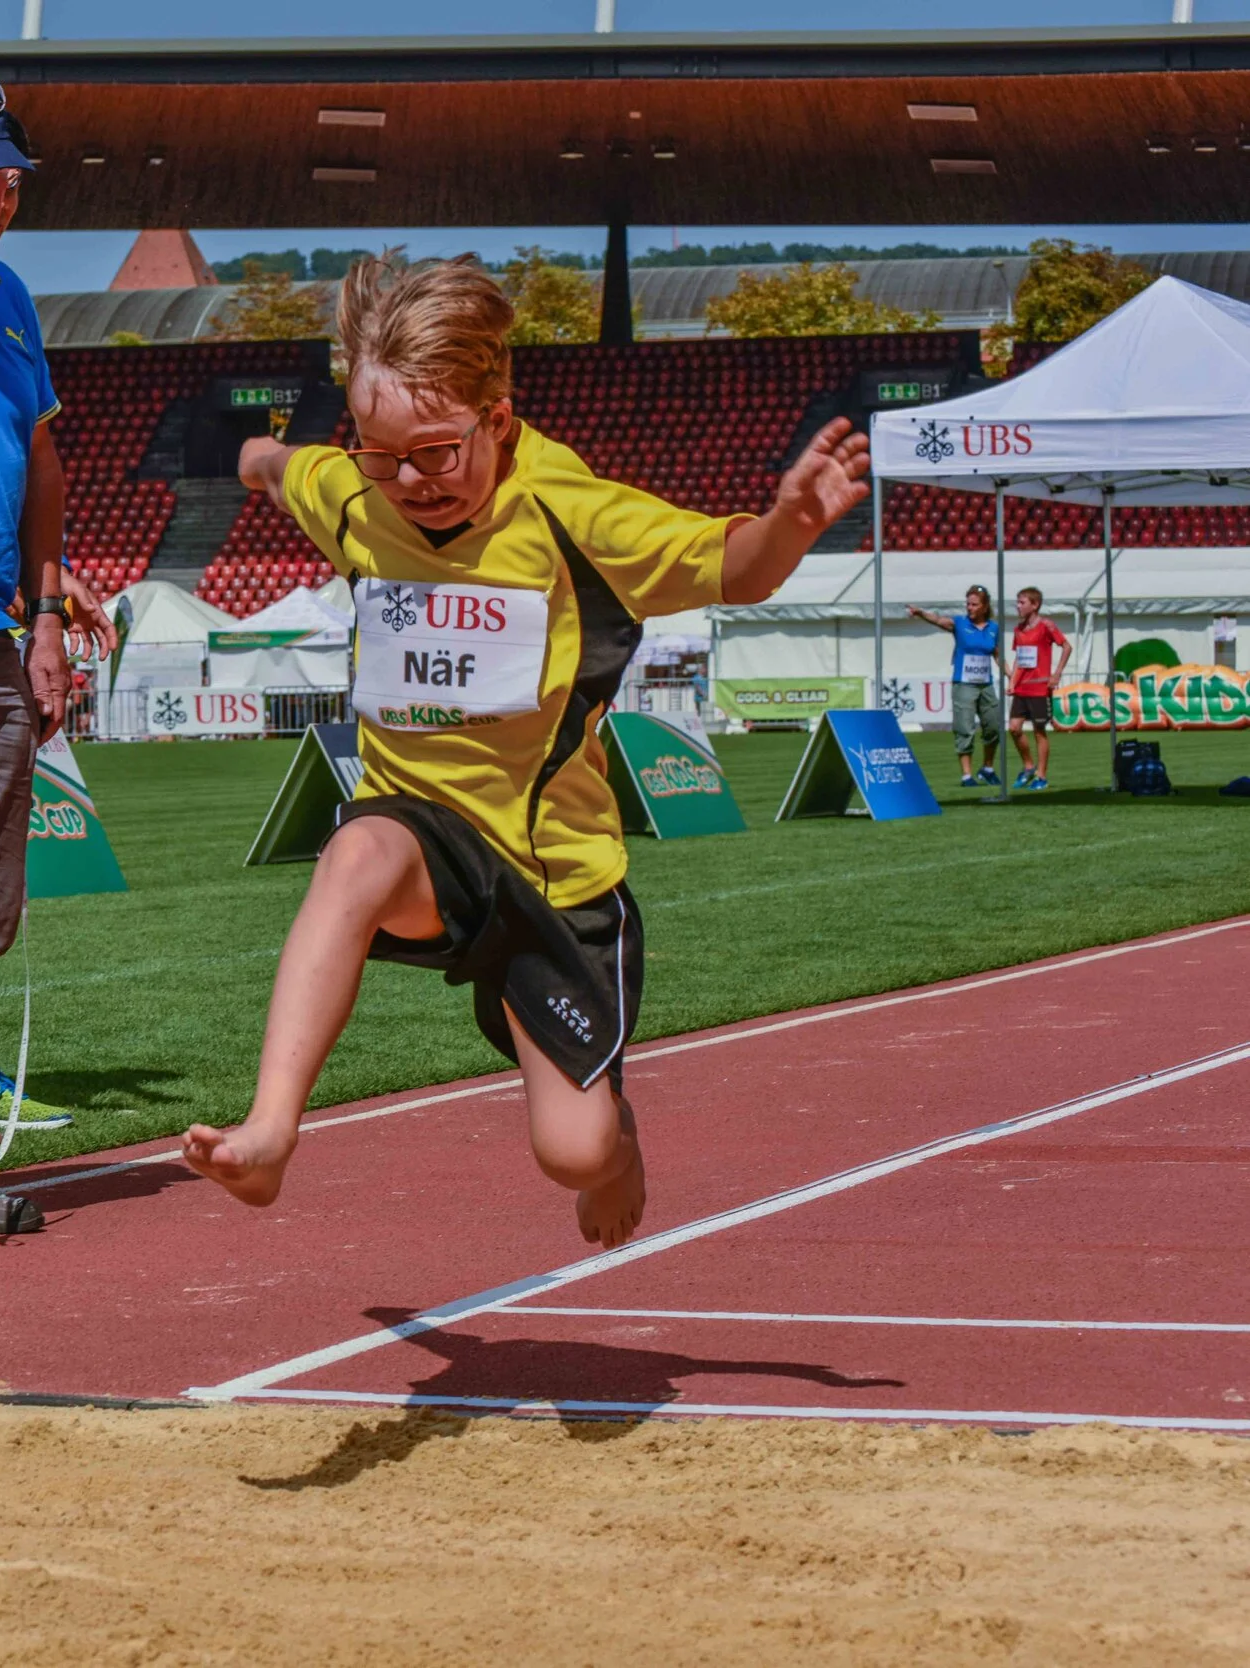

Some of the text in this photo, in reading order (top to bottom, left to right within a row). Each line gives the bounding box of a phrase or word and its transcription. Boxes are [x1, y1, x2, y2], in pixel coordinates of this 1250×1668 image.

[922, 383, 949, 399] B1
[961, 423, 1033, 456] UBS
[425, 593, 507, 632] UBS
[403, 650, 476, 688] Näf
[193, 692, 258, 724] UBS
[379, 706, 408, 726] UBS
[409, 703, 466, 729] KIDS
[1052, 673, 1250, 727] UBS KID
[45, 805, 84, 835] CUP
[547, 997, 594, 1044] extend
